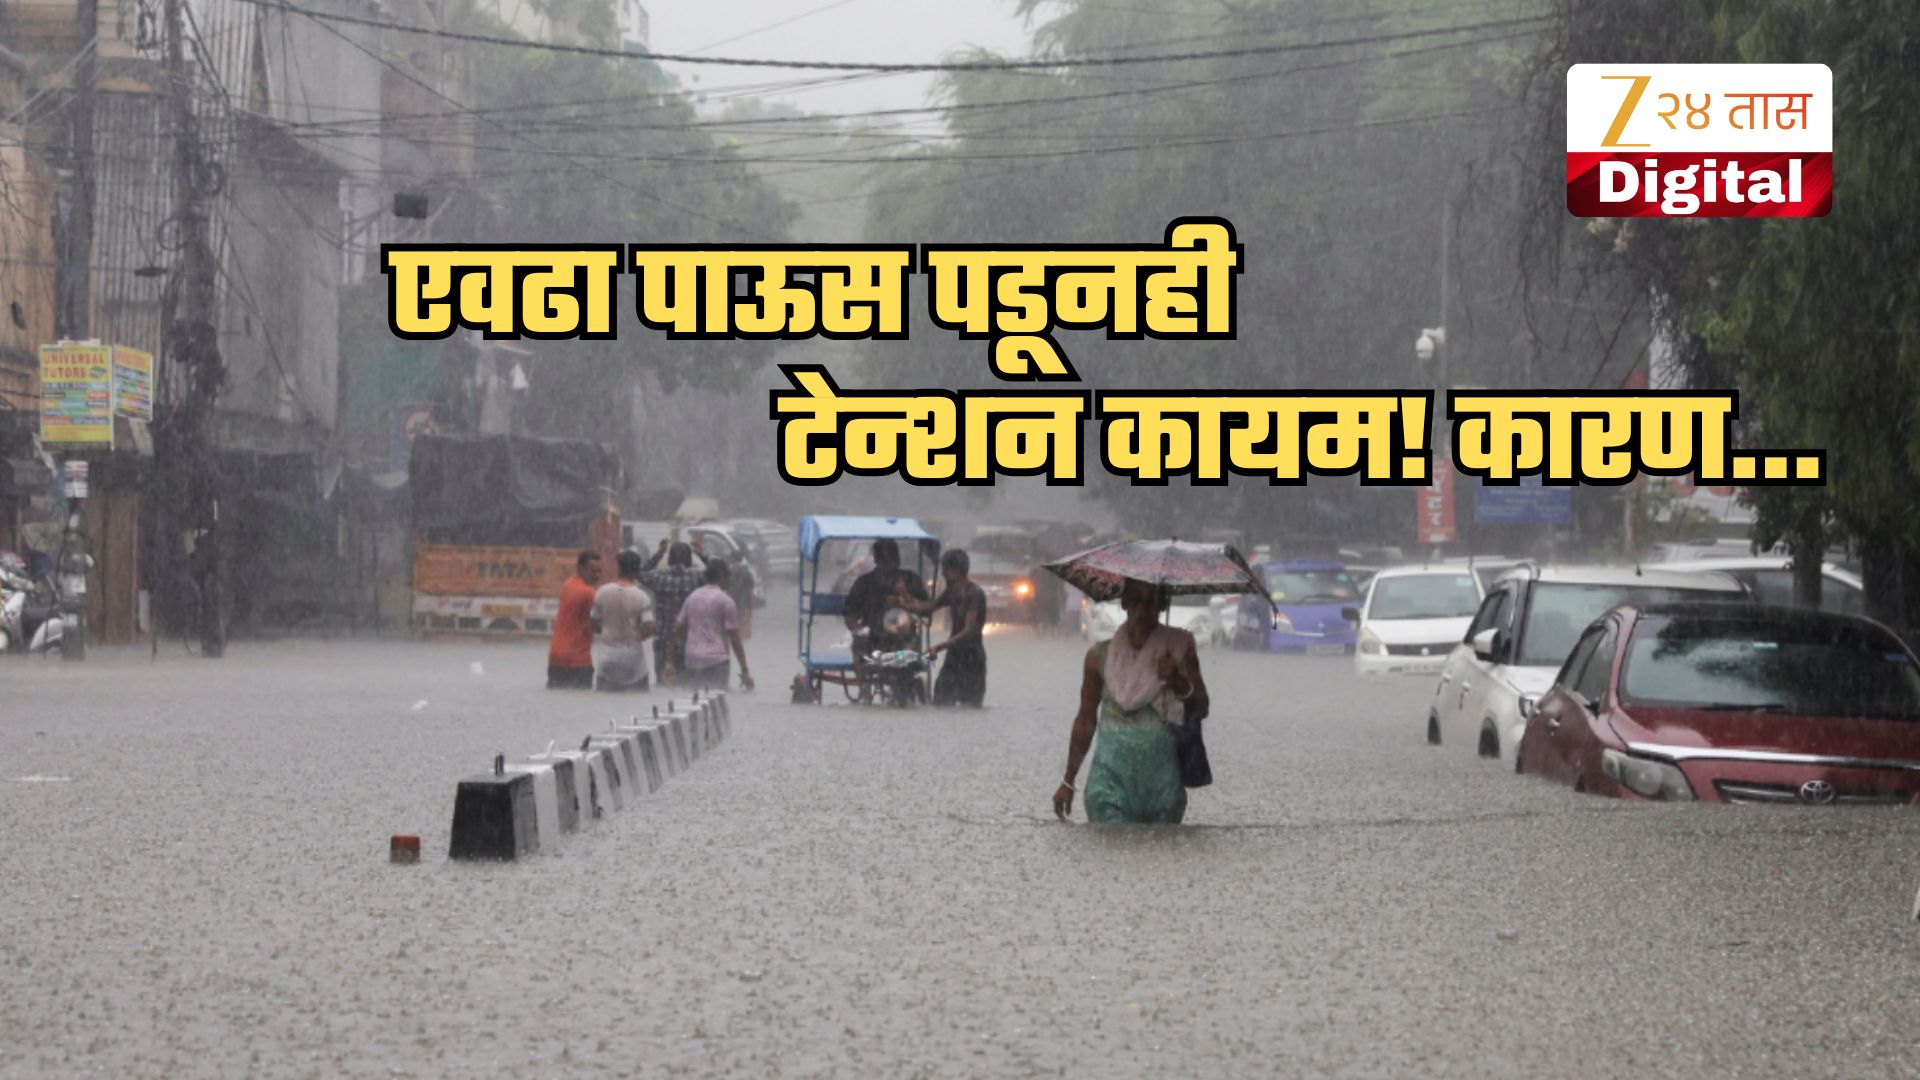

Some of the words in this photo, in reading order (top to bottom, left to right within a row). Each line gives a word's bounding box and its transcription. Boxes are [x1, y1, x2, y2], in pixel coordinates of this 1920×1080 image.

[44, 353, 104, 365] UNIVERSAL
[43, 368, 86, 379] TUTORS
[477, 561, 532, 577] TATA
